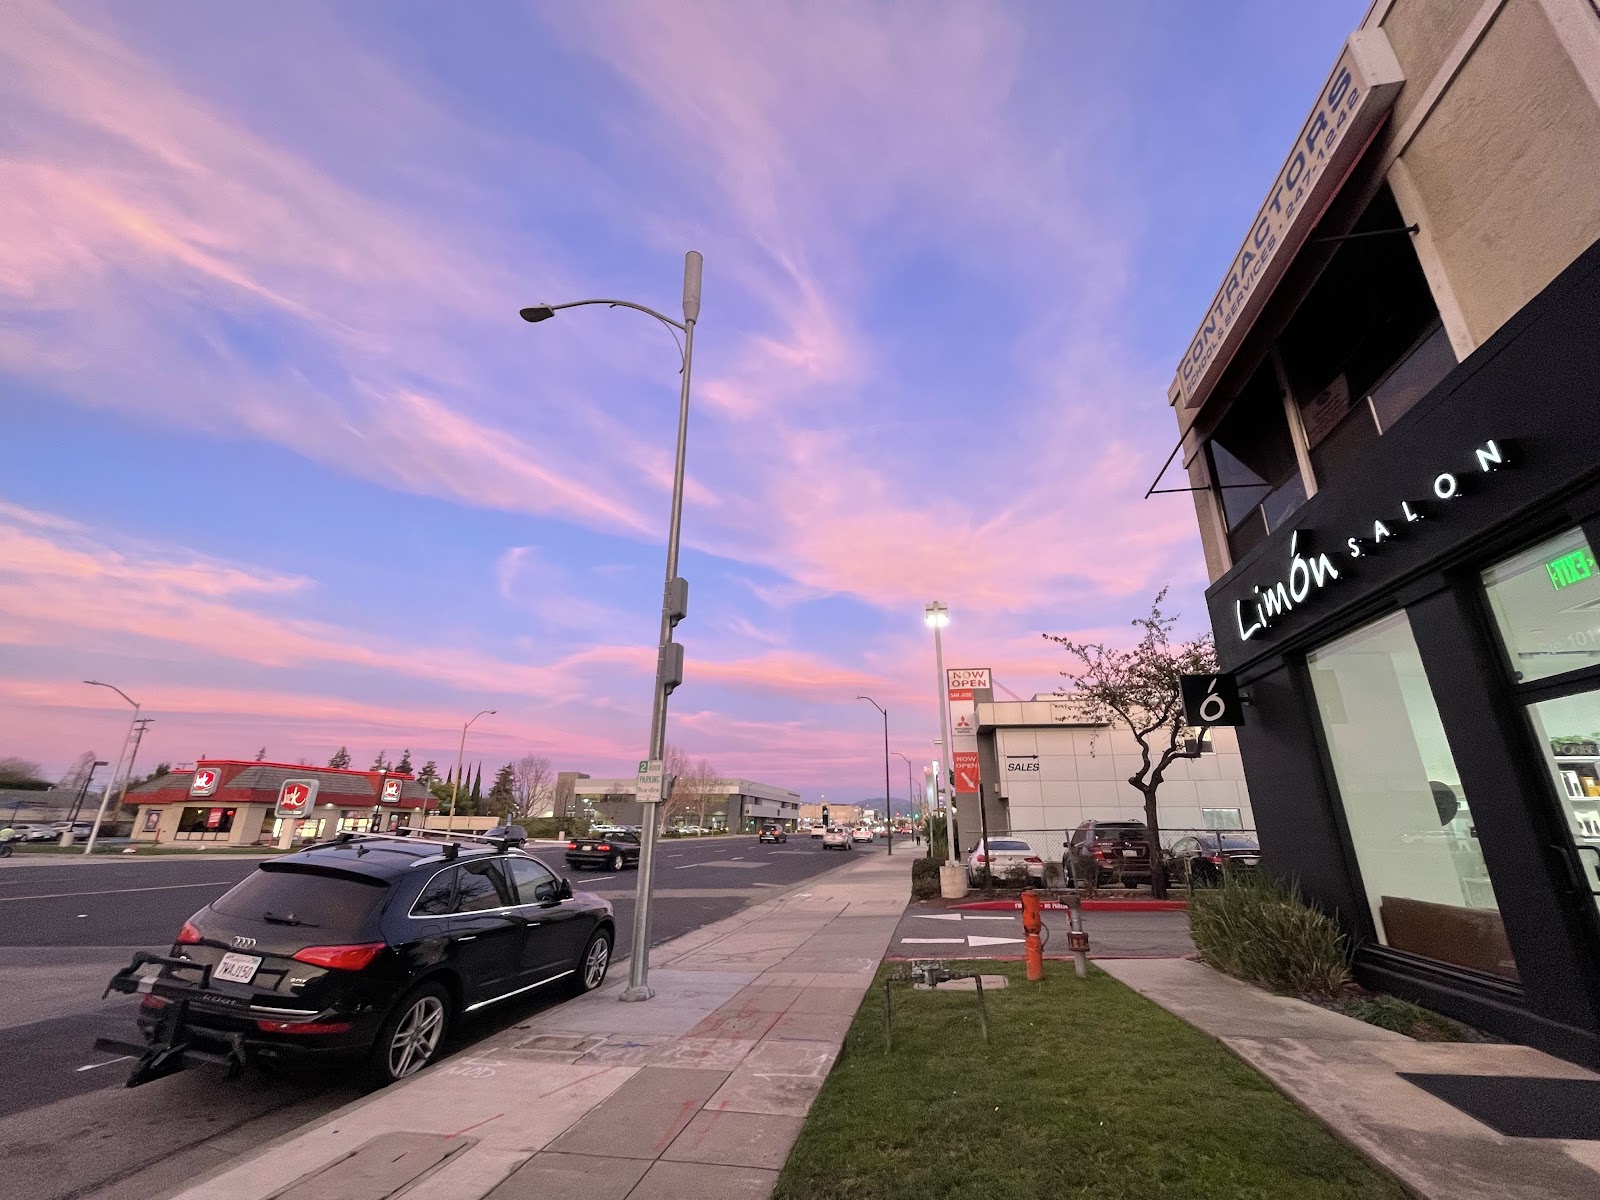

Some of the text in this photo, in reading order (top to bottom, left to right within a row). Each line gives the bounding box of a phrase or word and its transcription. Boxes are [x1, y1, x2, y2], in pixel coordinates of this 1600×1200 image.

[1183, 66, 1351, 381] CONTRACTORS
[1187, 87, 1360, 394] SCHOOL & SERVICES 247-1242
[1347, 440, 1503, 558] SALON
[953, 671, 984, 679] NOW
[951, 679, 986, 688] OPEN
[640, 762, 647, 772] 2
[1007, 763, 1040, 772] SALES
